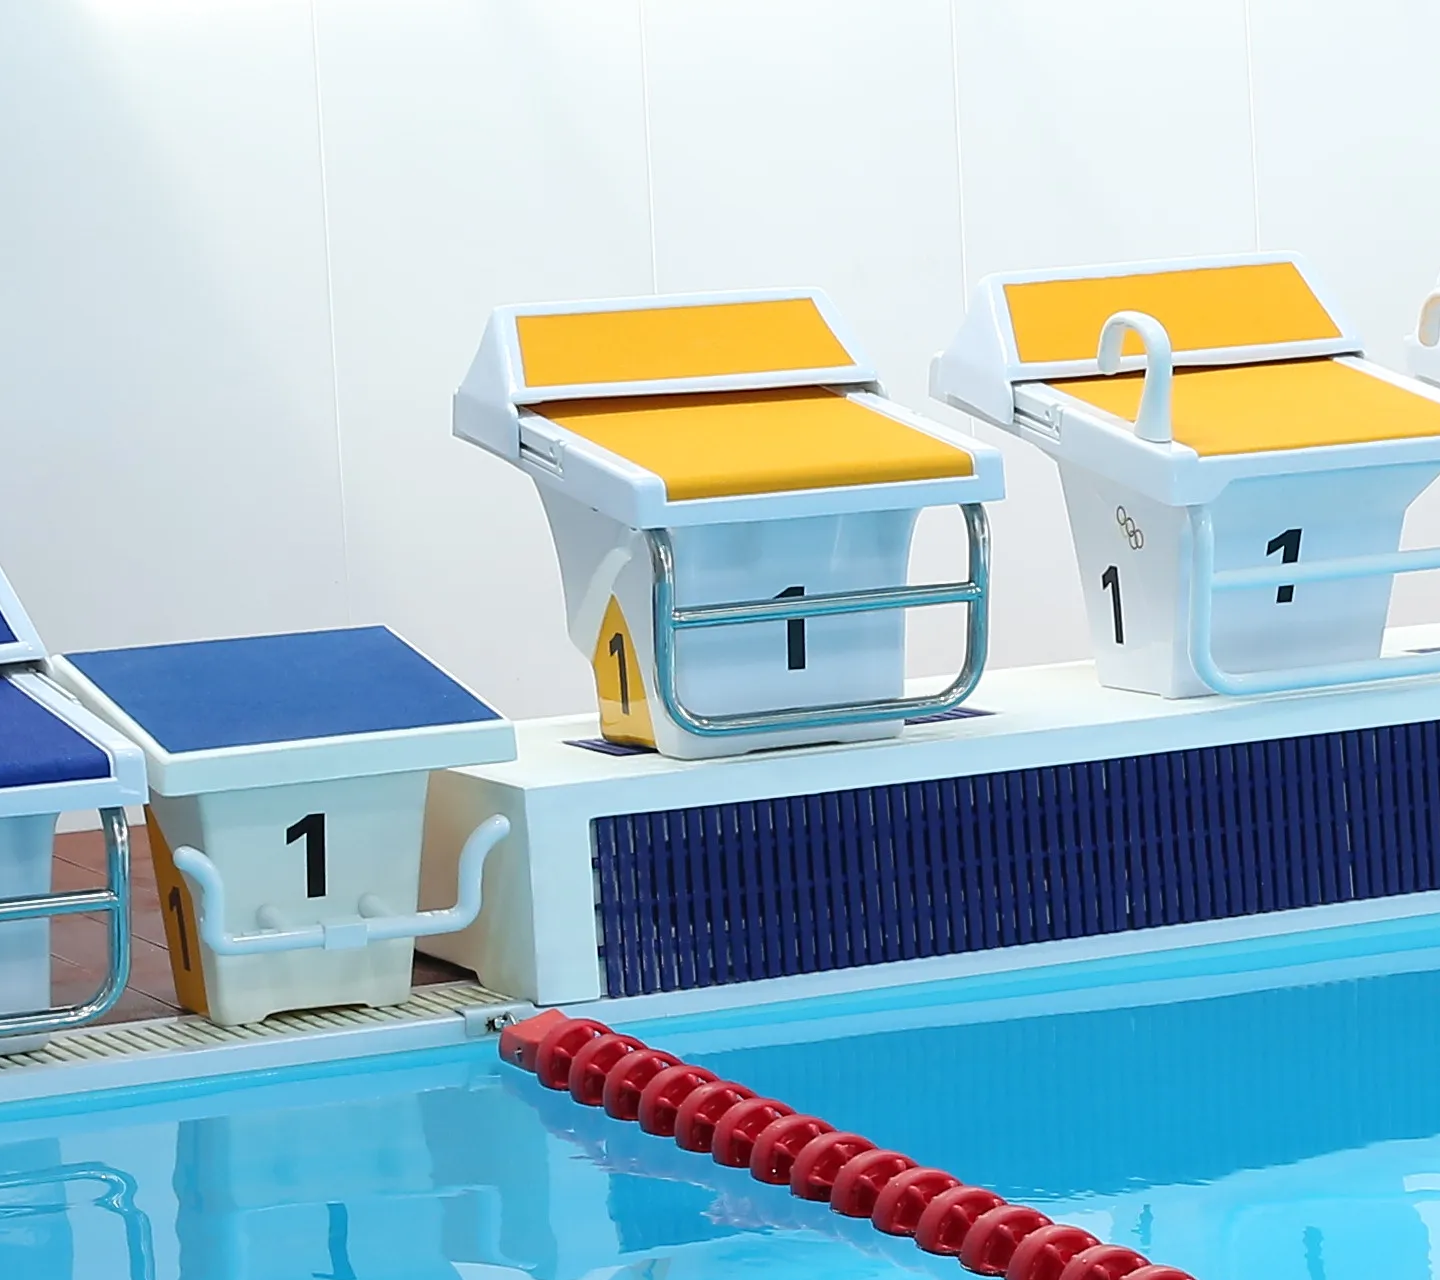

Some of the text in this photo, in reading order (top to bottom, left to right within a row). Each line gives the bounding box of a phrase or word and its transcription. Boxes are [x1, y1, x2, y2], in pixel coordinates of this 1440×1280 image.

[1101, 565, 1124, 644] 1
[1265, 528, 1304, 604] 1
[770, 586, 806, 670] 1
[608, 632, 630, 715] 1
[286, 812, 327, 898] 1
[168, 886, 192, 972] 1
